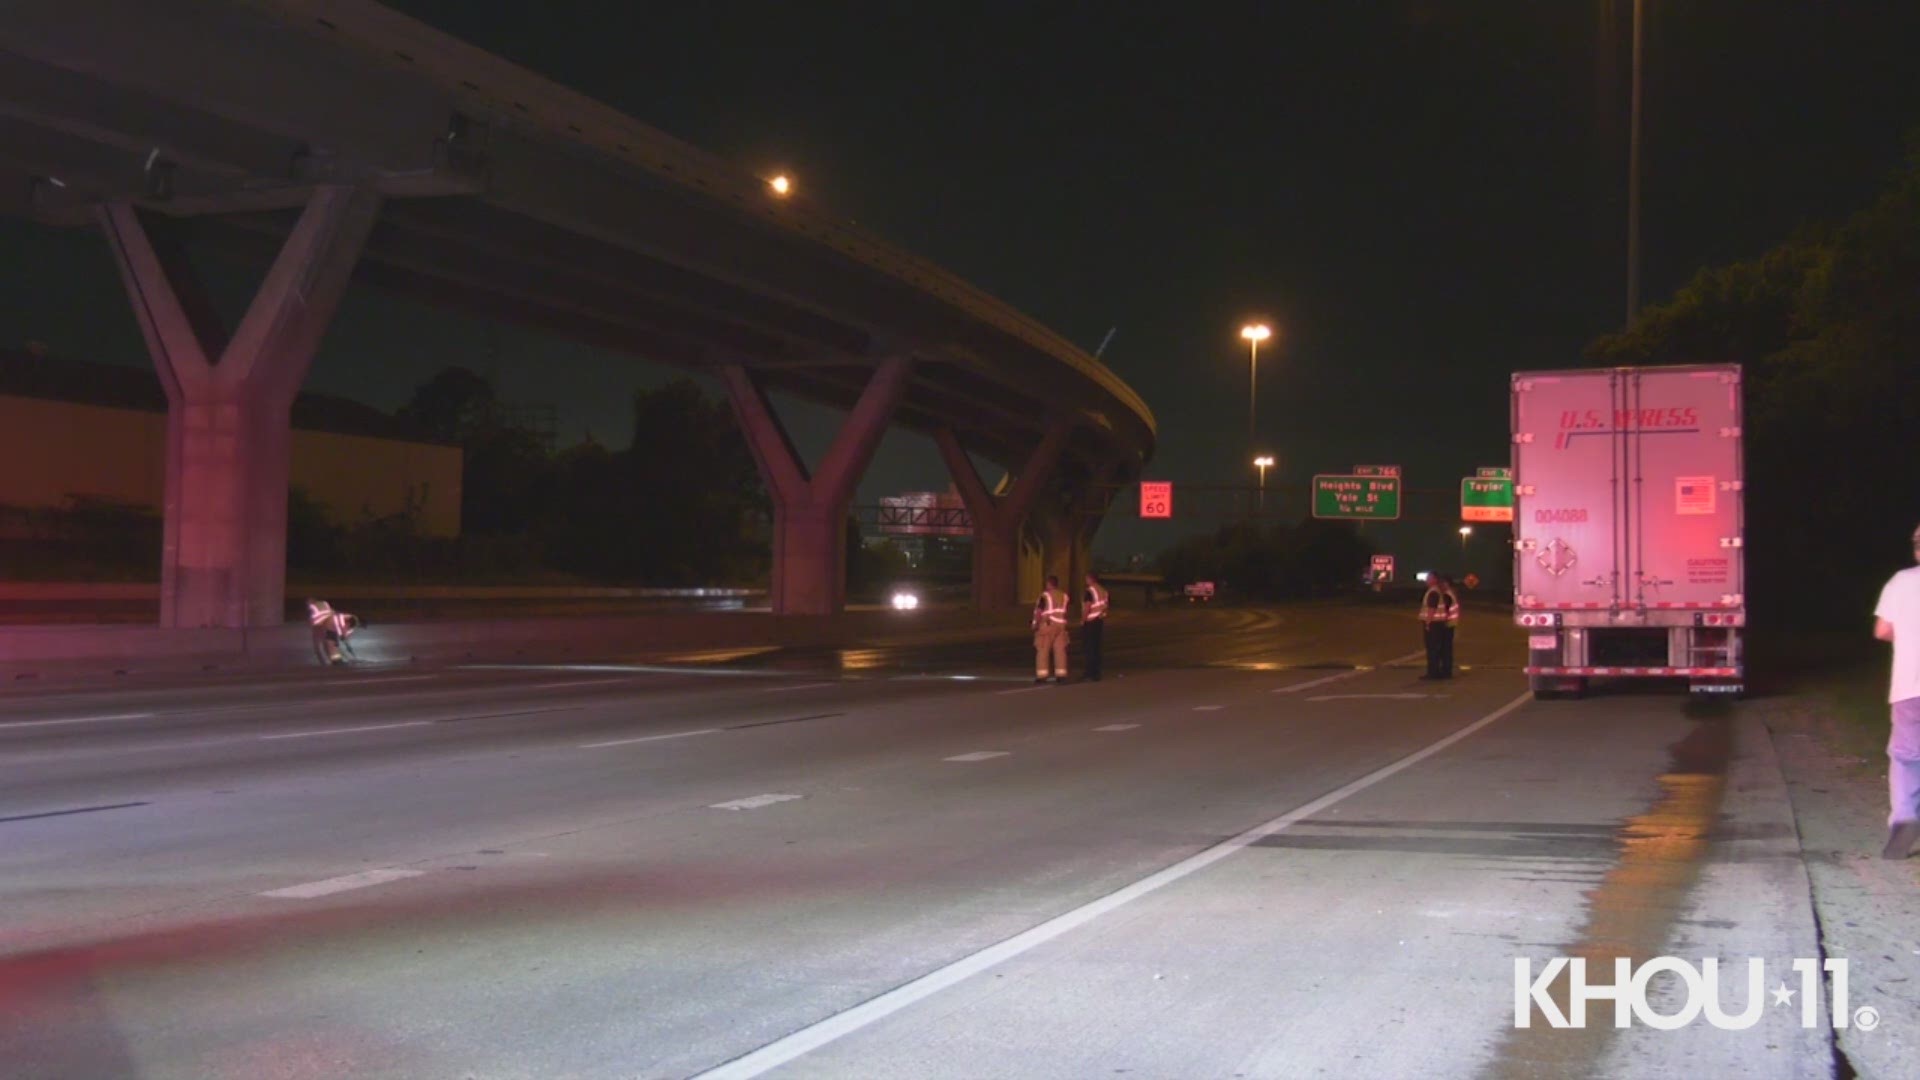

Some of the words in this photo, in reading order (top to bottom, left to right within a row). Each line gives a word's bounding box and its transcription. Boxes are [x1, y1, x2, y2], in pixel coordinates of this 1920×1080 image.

[1560, 410, 1604, 428] U.S.
[1320, 481, 1361, 491] Heights
[1369, 482, 1394, 490] Blvd
[1470, 482, 1504, 491] Taylor
[1335, 493, 1358, 502] Yale
[1367, 493, 1379, 502] St
[1146, 502, 1165, 513] 60
